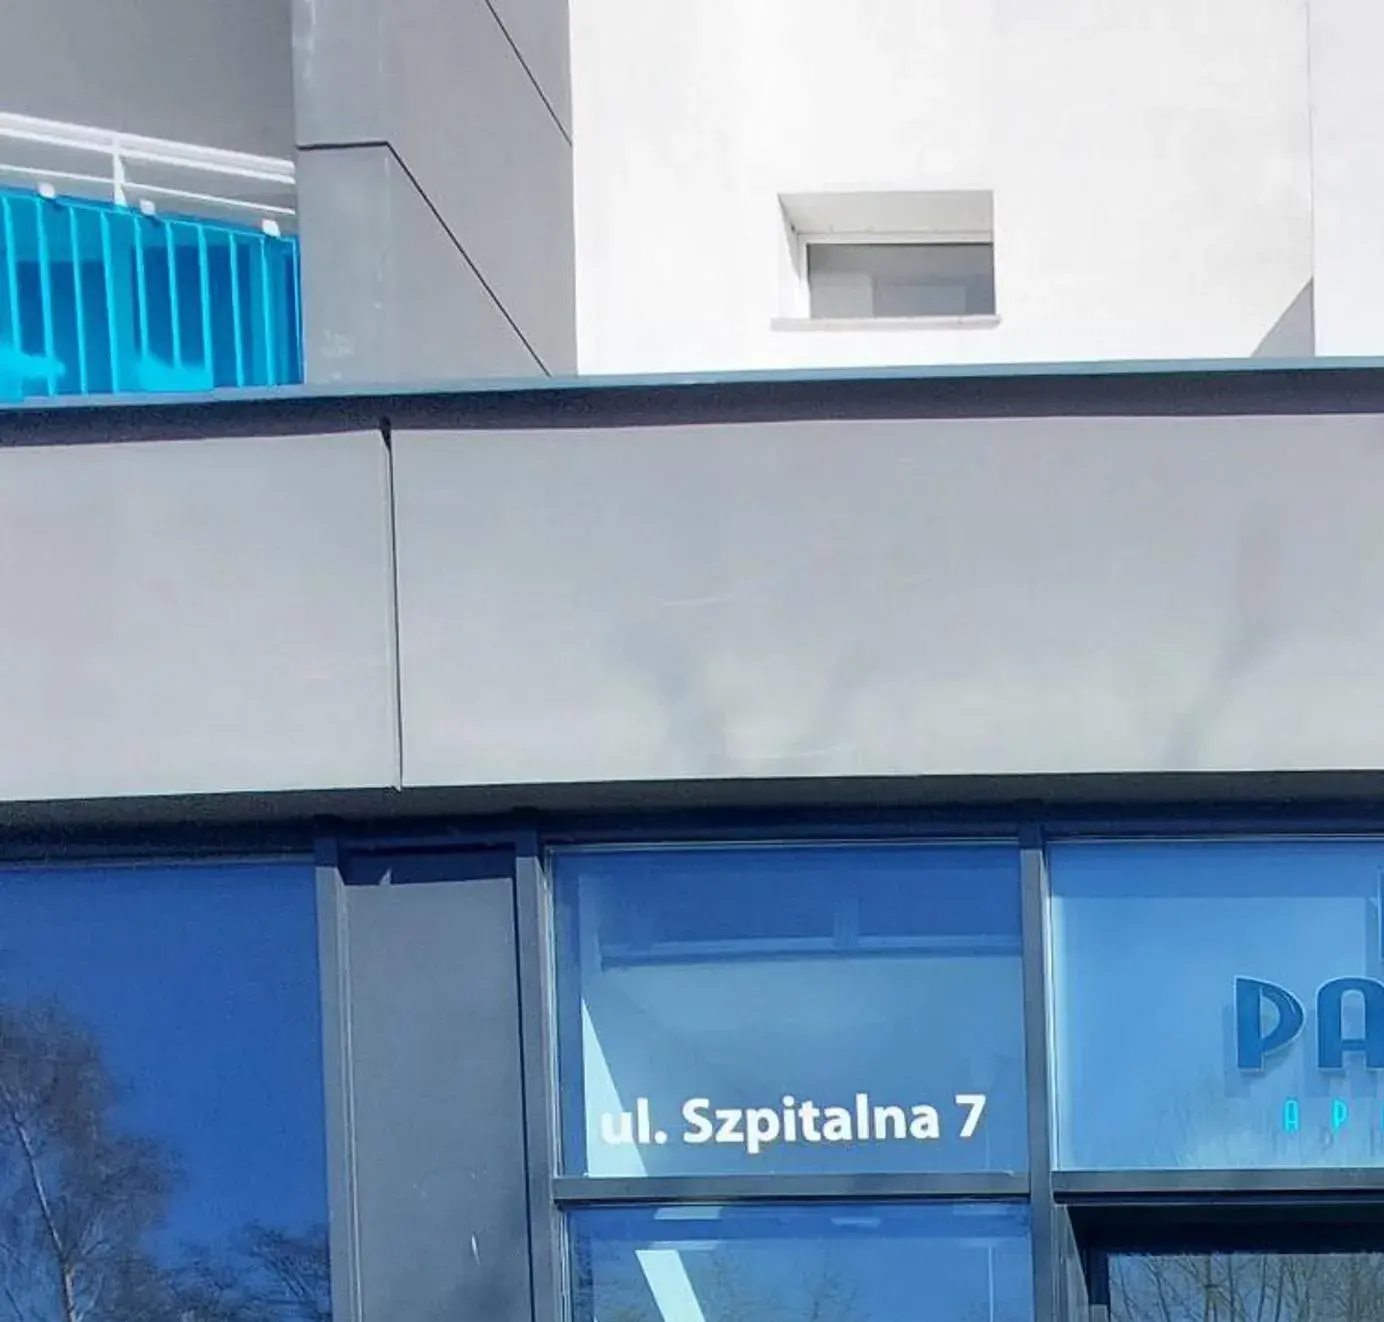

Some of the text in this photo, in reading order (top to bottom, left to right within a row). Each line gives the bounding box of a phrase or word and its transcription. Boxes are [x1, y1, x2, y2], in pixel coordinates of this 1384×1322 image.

[600, 1093, 987, 1154] ul. Szpitalna 7
